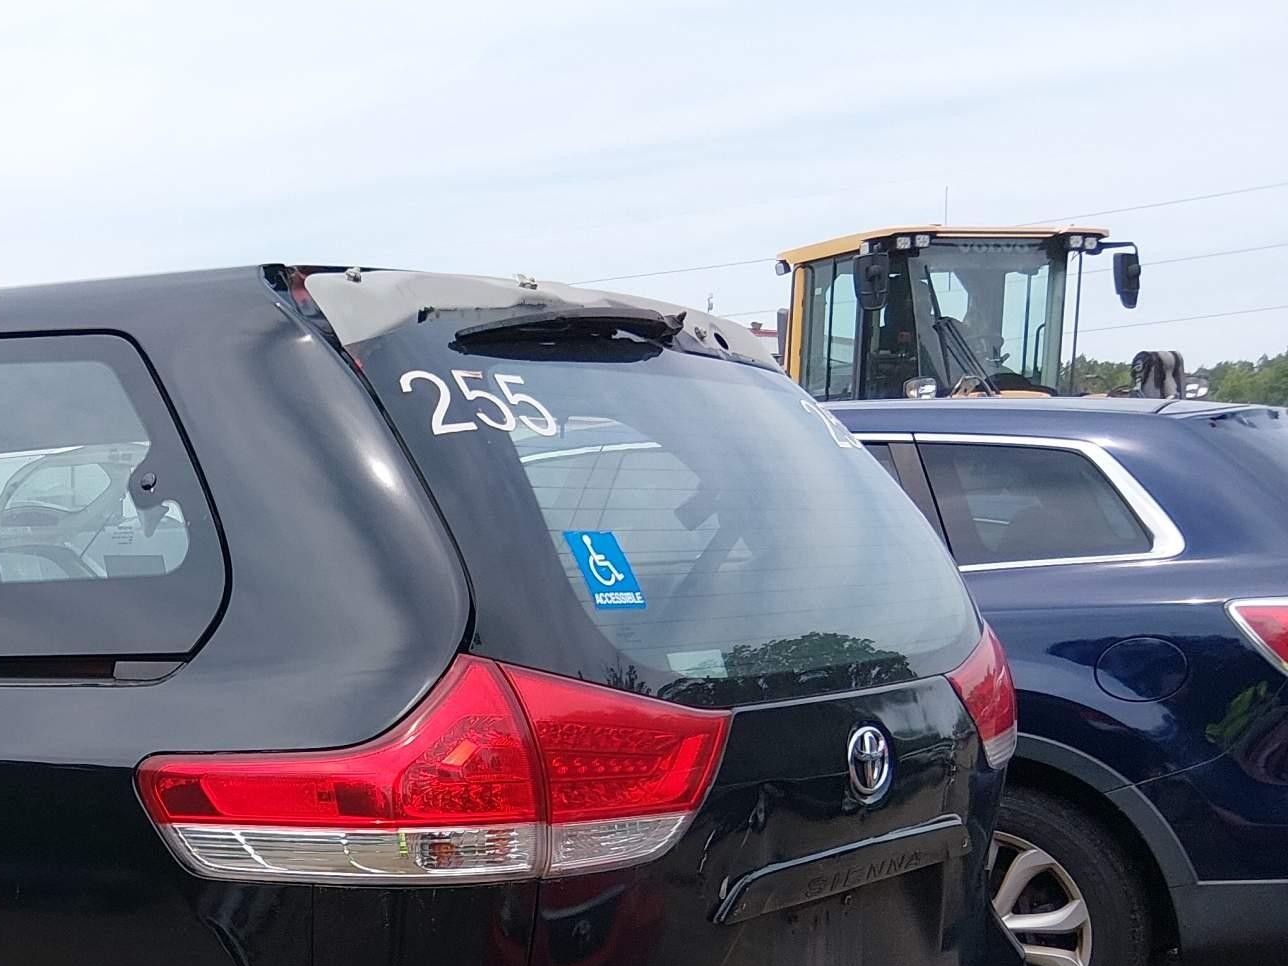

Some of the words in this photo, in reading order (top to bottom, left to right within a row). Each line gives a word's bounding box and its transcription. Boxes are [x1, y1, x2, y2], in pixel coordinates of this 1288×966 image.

[399, 369, 558, 437] 255
[595, 592, 645, 606] ACCESSIBLE
[805, 850, 921, 898] SIENNA
